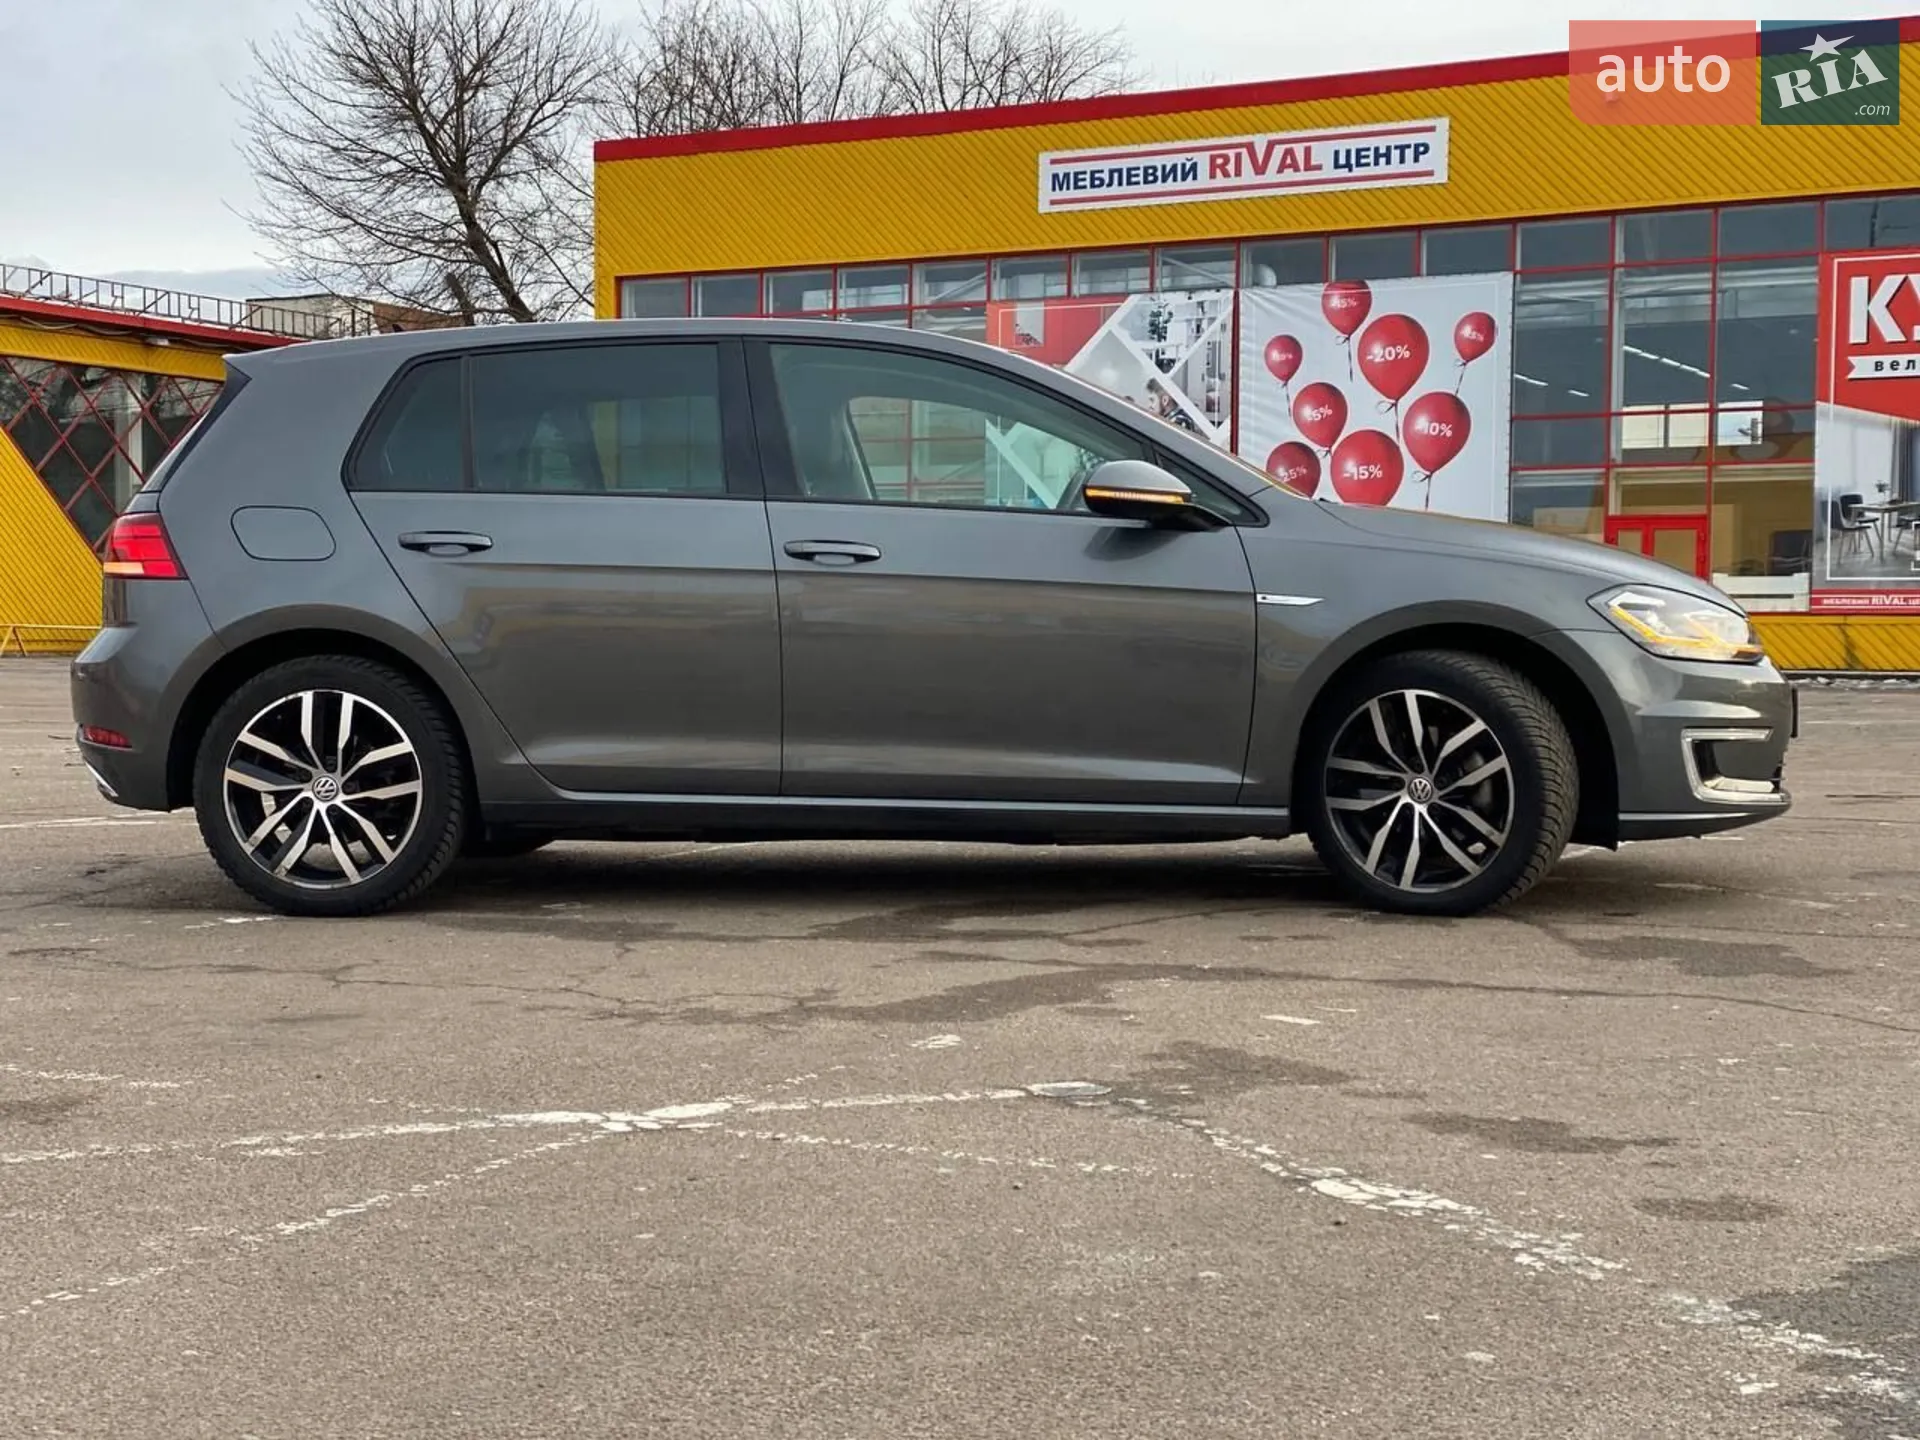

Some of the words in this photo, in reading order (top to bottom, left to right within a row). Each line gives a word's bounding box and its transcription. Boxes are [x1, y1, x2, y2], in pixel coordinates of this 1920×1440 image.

[1050, 157, 1198, 192] МЕБЛЕВИЙ
[1208, 140, 1323, 180] RIVAL
[1333, 141, 1431, 173] ЦЕНТР
[1848, 273, 1920, 344] К
[1366, 344, 1411, 363] -20%
[1343, 463, 1383, 480] -15%
